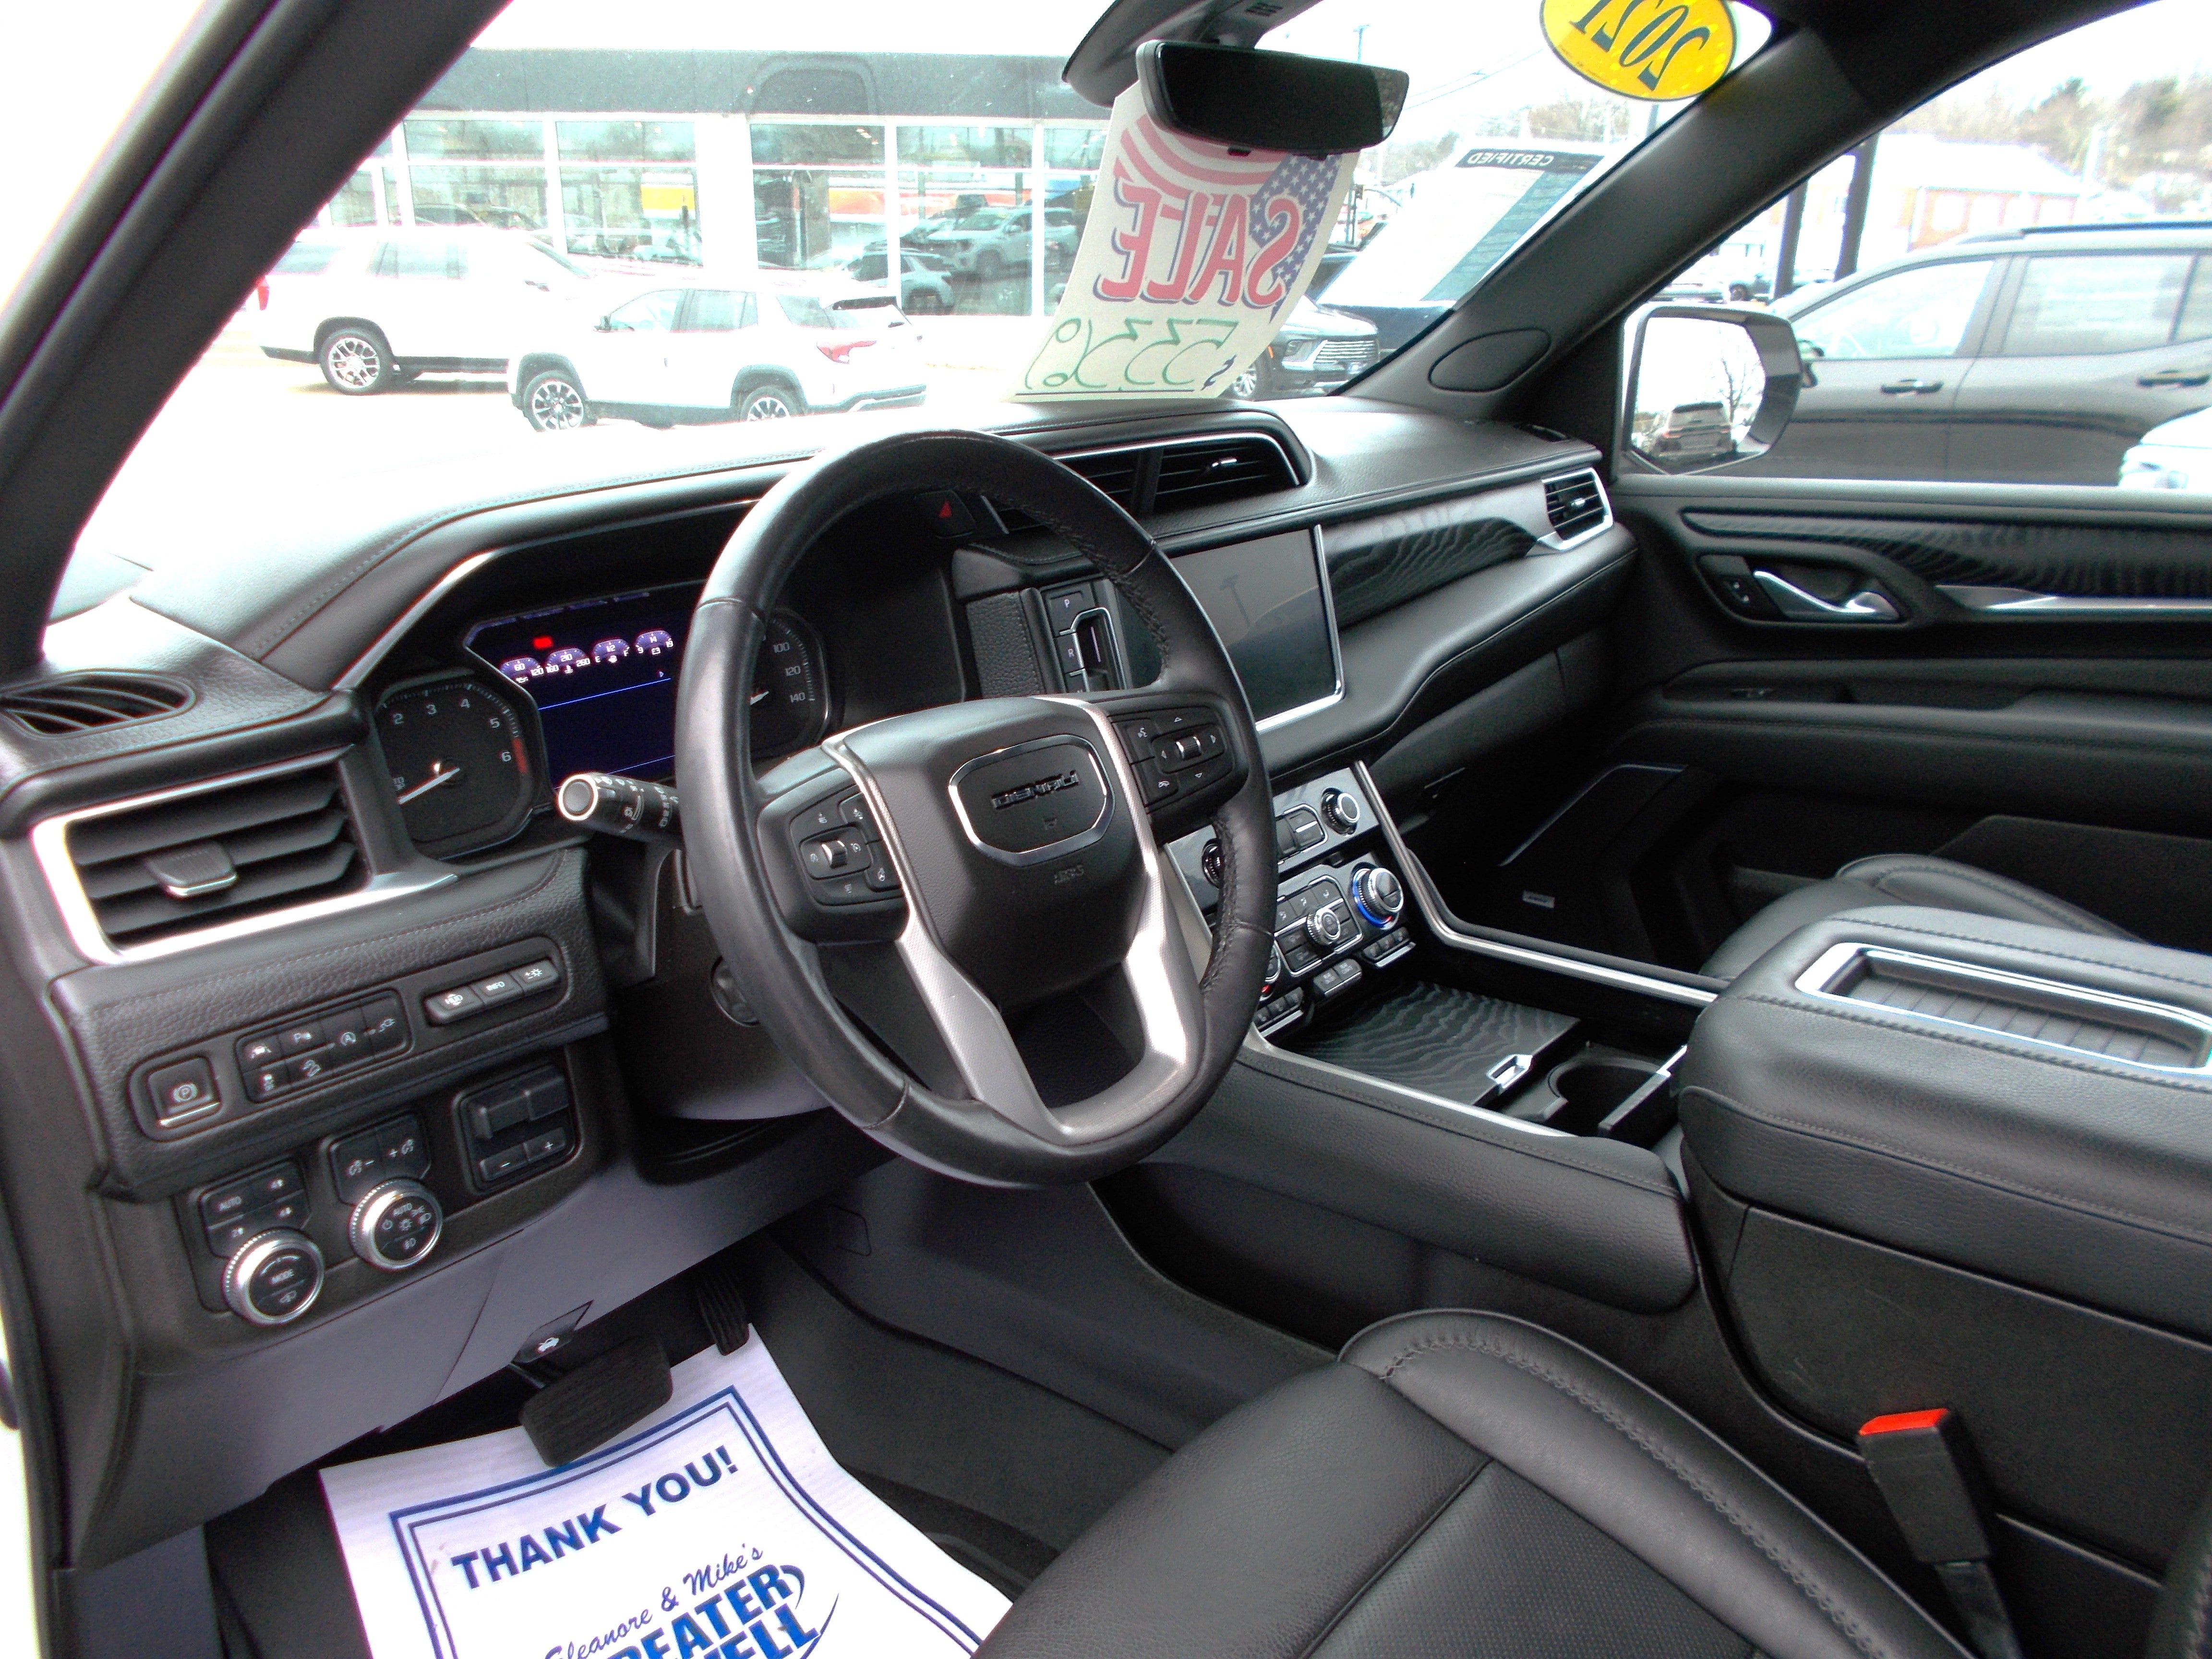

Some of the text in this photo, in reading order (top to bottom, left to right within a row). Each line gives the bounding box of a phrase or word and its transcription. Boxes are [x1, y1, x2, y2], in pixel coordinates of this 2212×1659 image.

[460, 698, 470, 708] 4
[425, 704, 437, 715] 3
[393, 713, 404, 725] 2
[489, 718, 501, 728] 5
[501, 751, 512, 762] 6
[451, 1445, 739, 1589] THANK YOU!
[661, 1586, 679, 1612] &
[683, 1542, 764, 1596] Mike's
[703, 1602, 819, 1659] ELL
